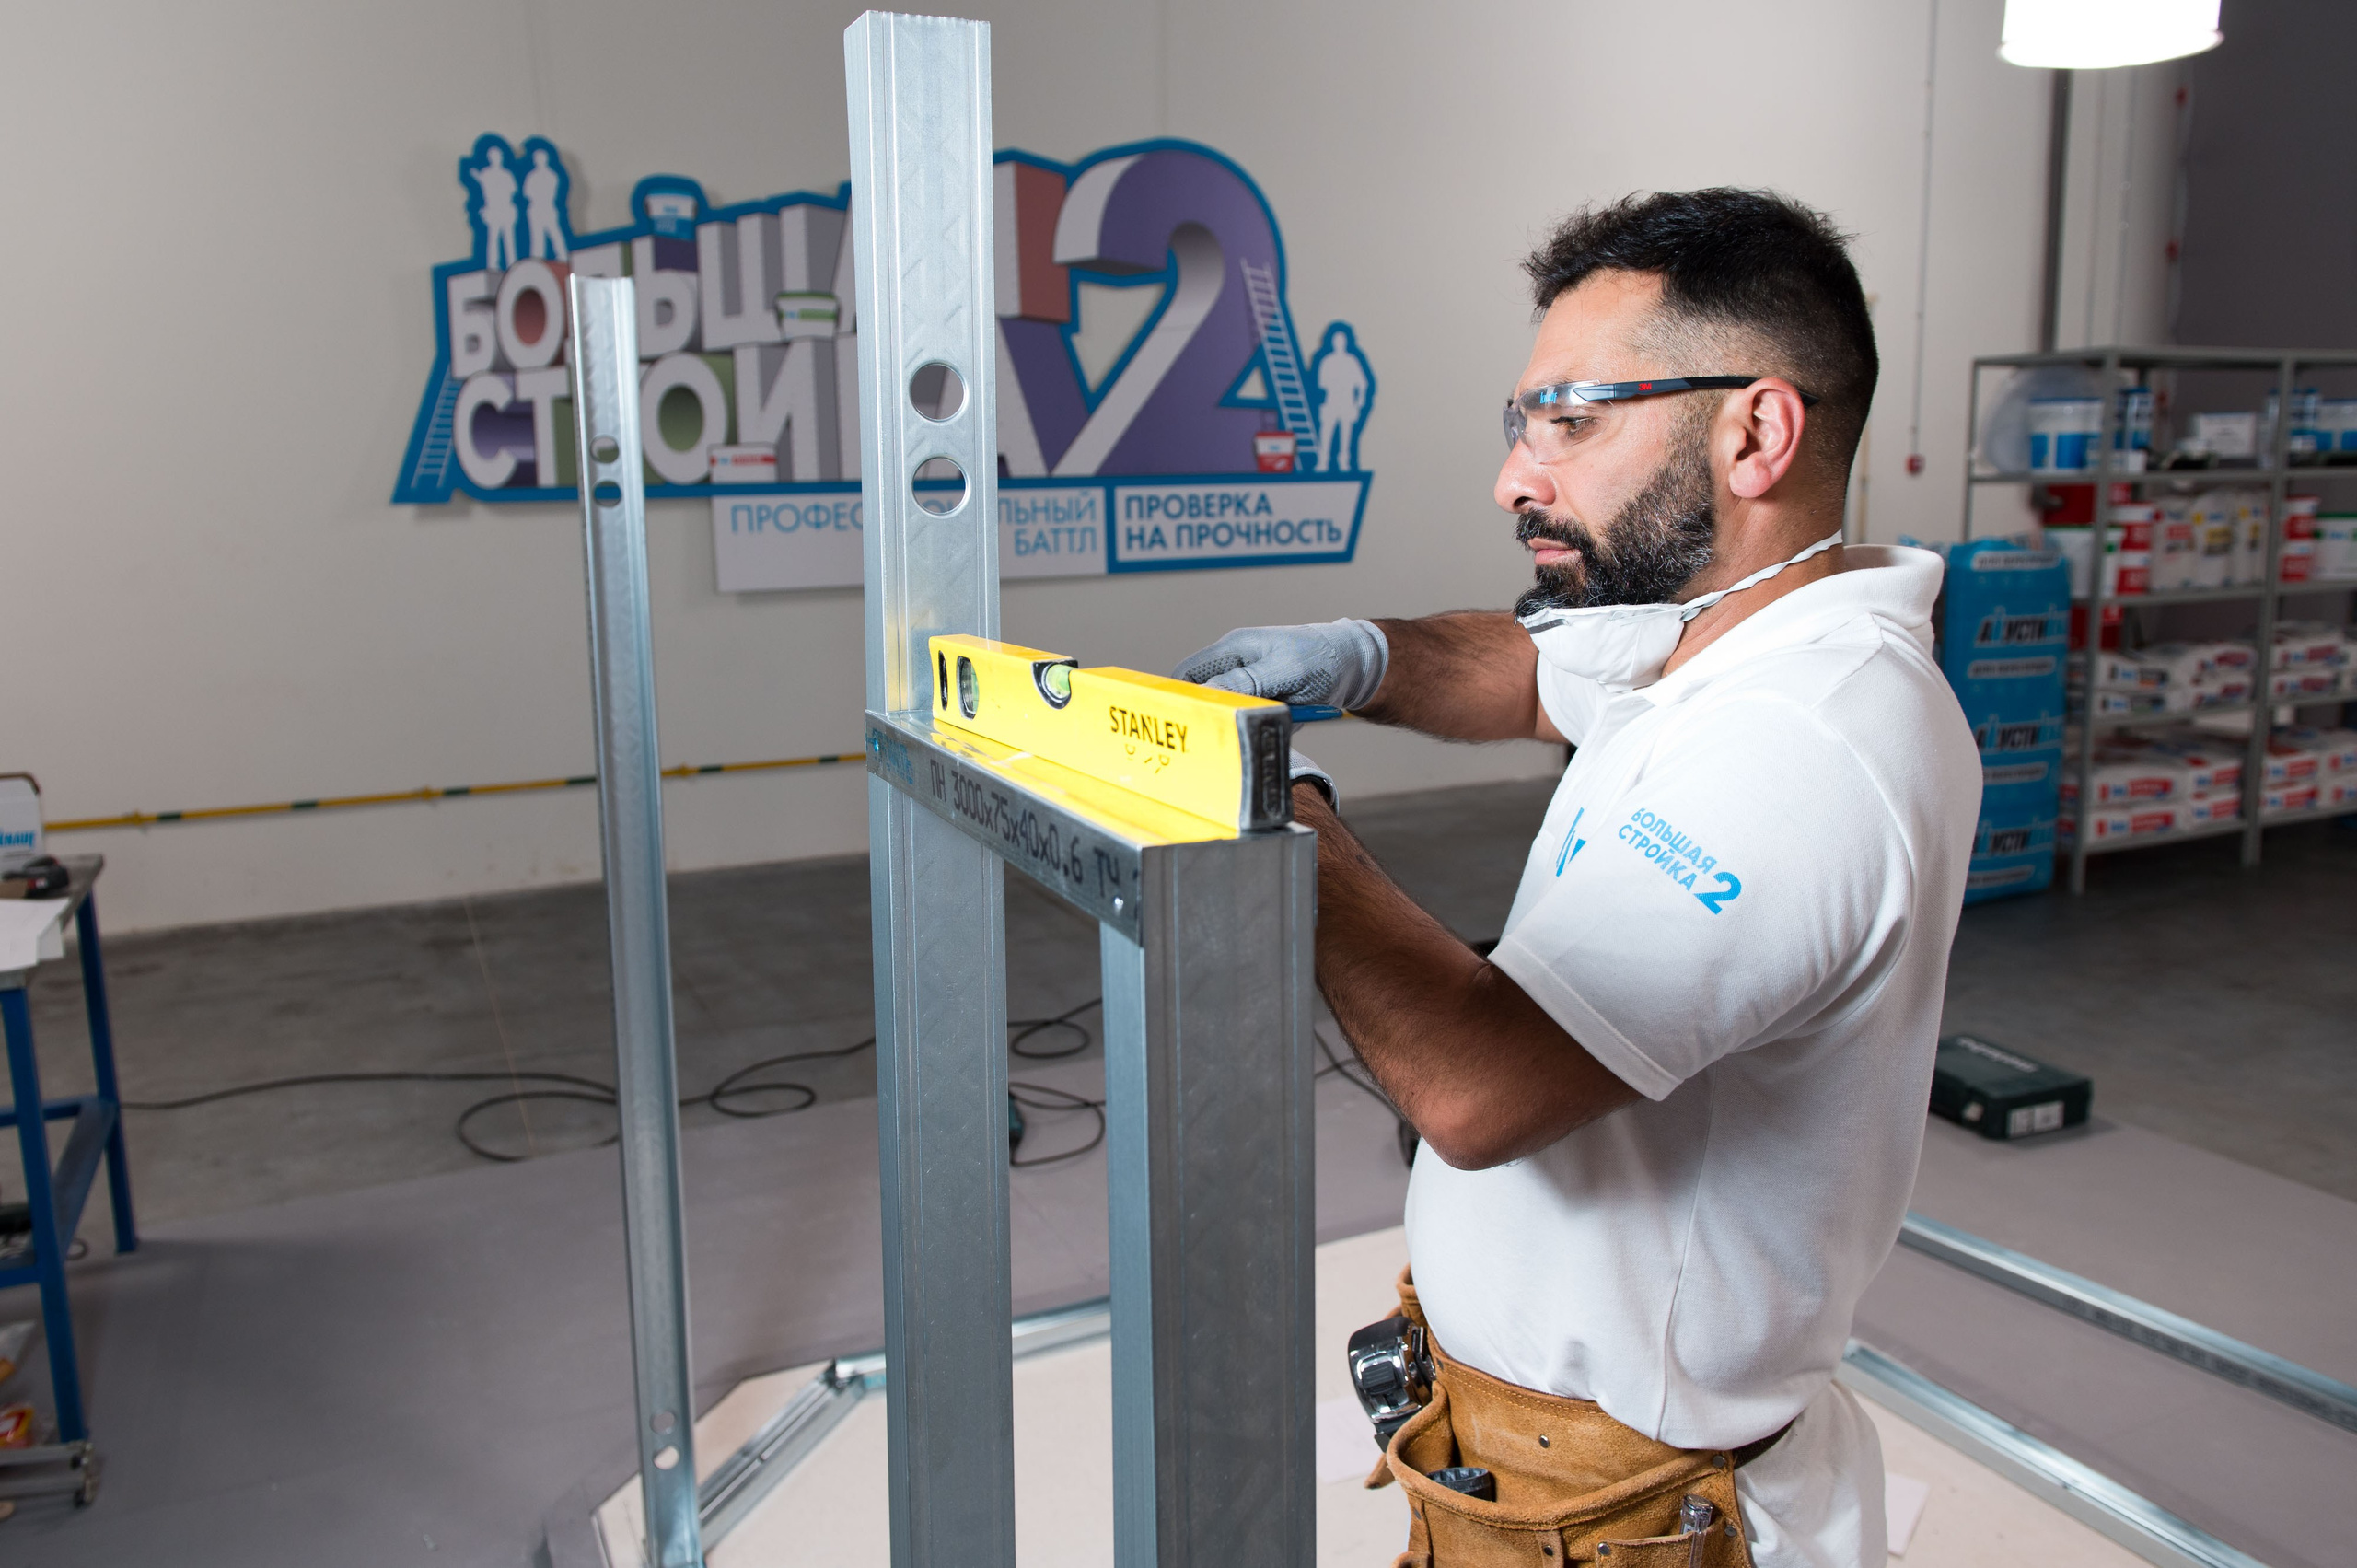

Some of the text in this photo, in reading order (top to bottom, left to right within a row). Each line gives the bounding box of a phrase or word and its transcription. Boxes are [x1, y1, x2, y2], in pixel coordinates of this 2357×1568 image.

[1051, 150, 1283, 478] 2
[1637, 382, 1653, 391] 3M
[1124, 491, 1273, 521] ПРОВЕРКА
[1014, 526, 1097, 557] БАТТЛ
[1125, 517, 1343, 552] НА ПРОЧНОСТЬ
[1109, 705, 1188, 753] STANLEY
[930, 758, 947, 803] ПН
[1630, 807, 1718, 875] БОЛЬШАЯ
[1618, 824, 1698, 892] СТРОЙКА
[1693, 871, 1743, 916] 2
